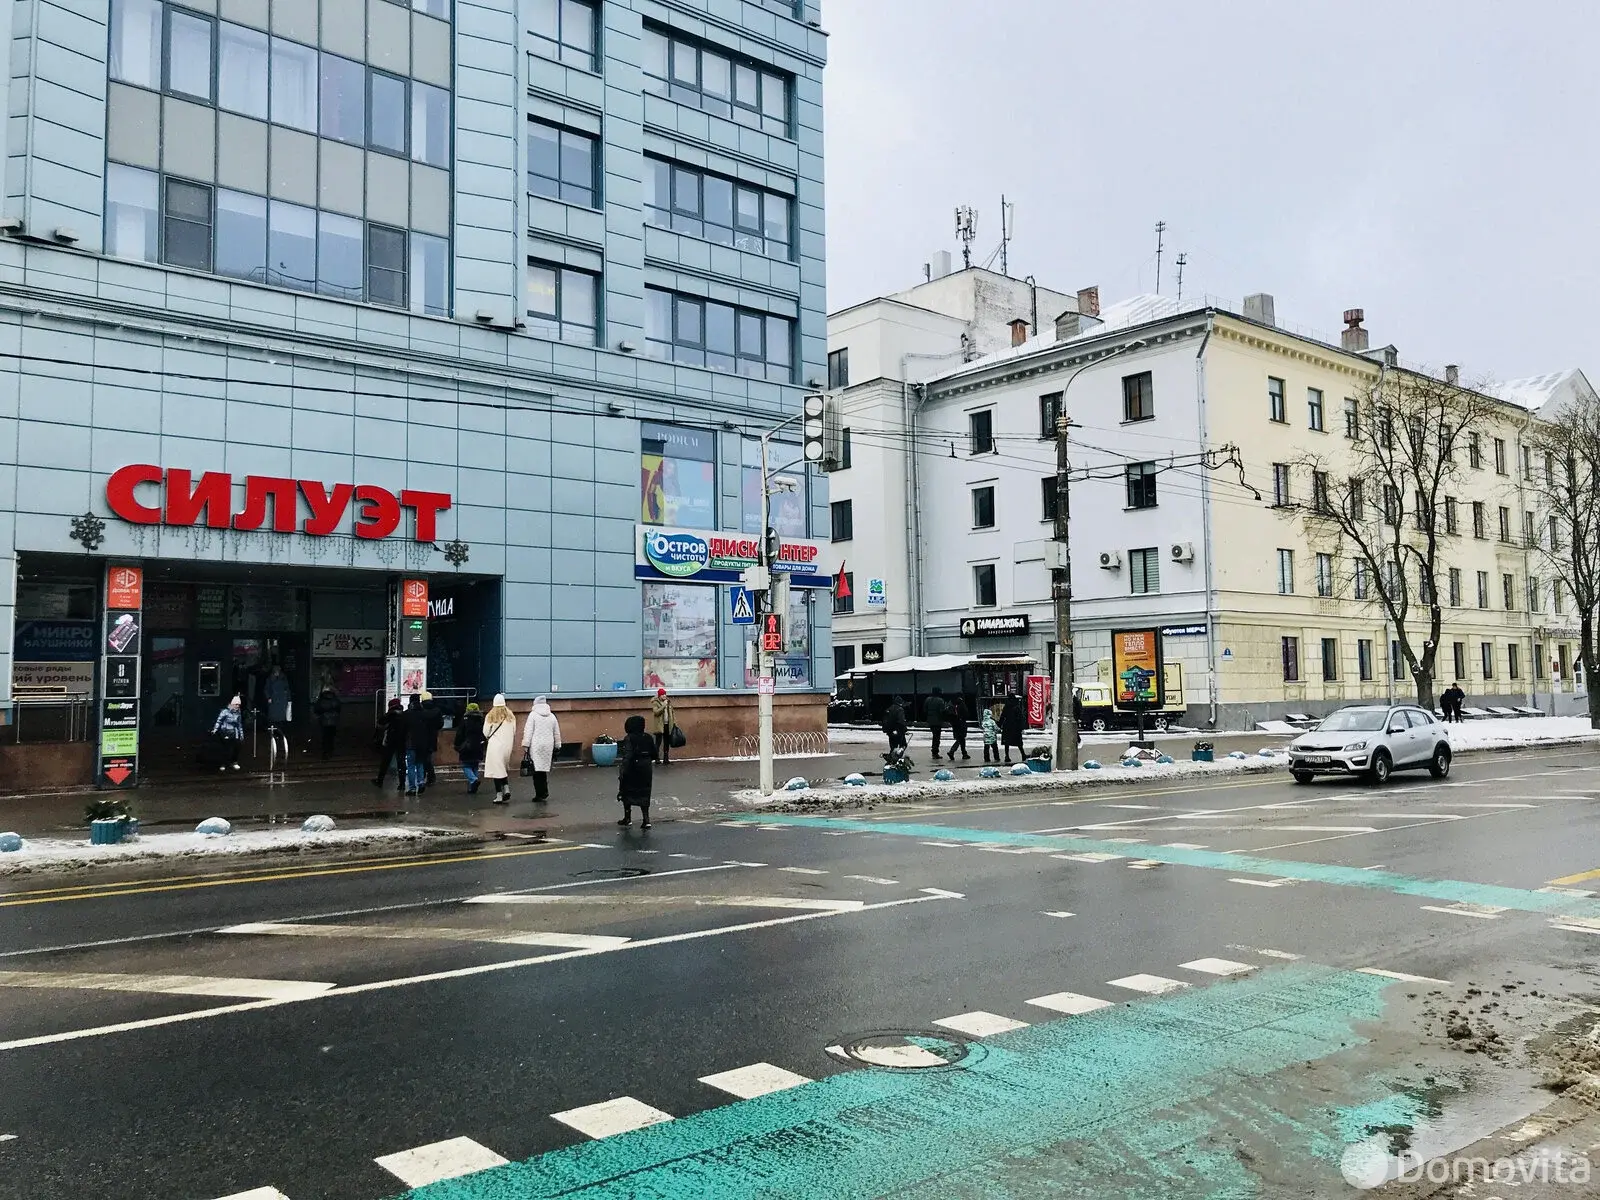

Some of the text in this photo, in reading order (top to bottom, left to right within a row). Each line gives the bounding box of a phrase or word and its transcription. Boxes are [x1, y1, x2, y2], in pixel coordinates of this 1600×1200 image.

[106, 463, 452, 543] СИЛУЭТ
[710, 537, 818, 561] ДИСКНТЕР
[772, 563, 792, 571] ТОВАРЫ
[32, 626, 94, 639] МИКРО
[23, 639, 93, 648] НАУШНИКИ
[12, 673, 92, 684] ий уровень
